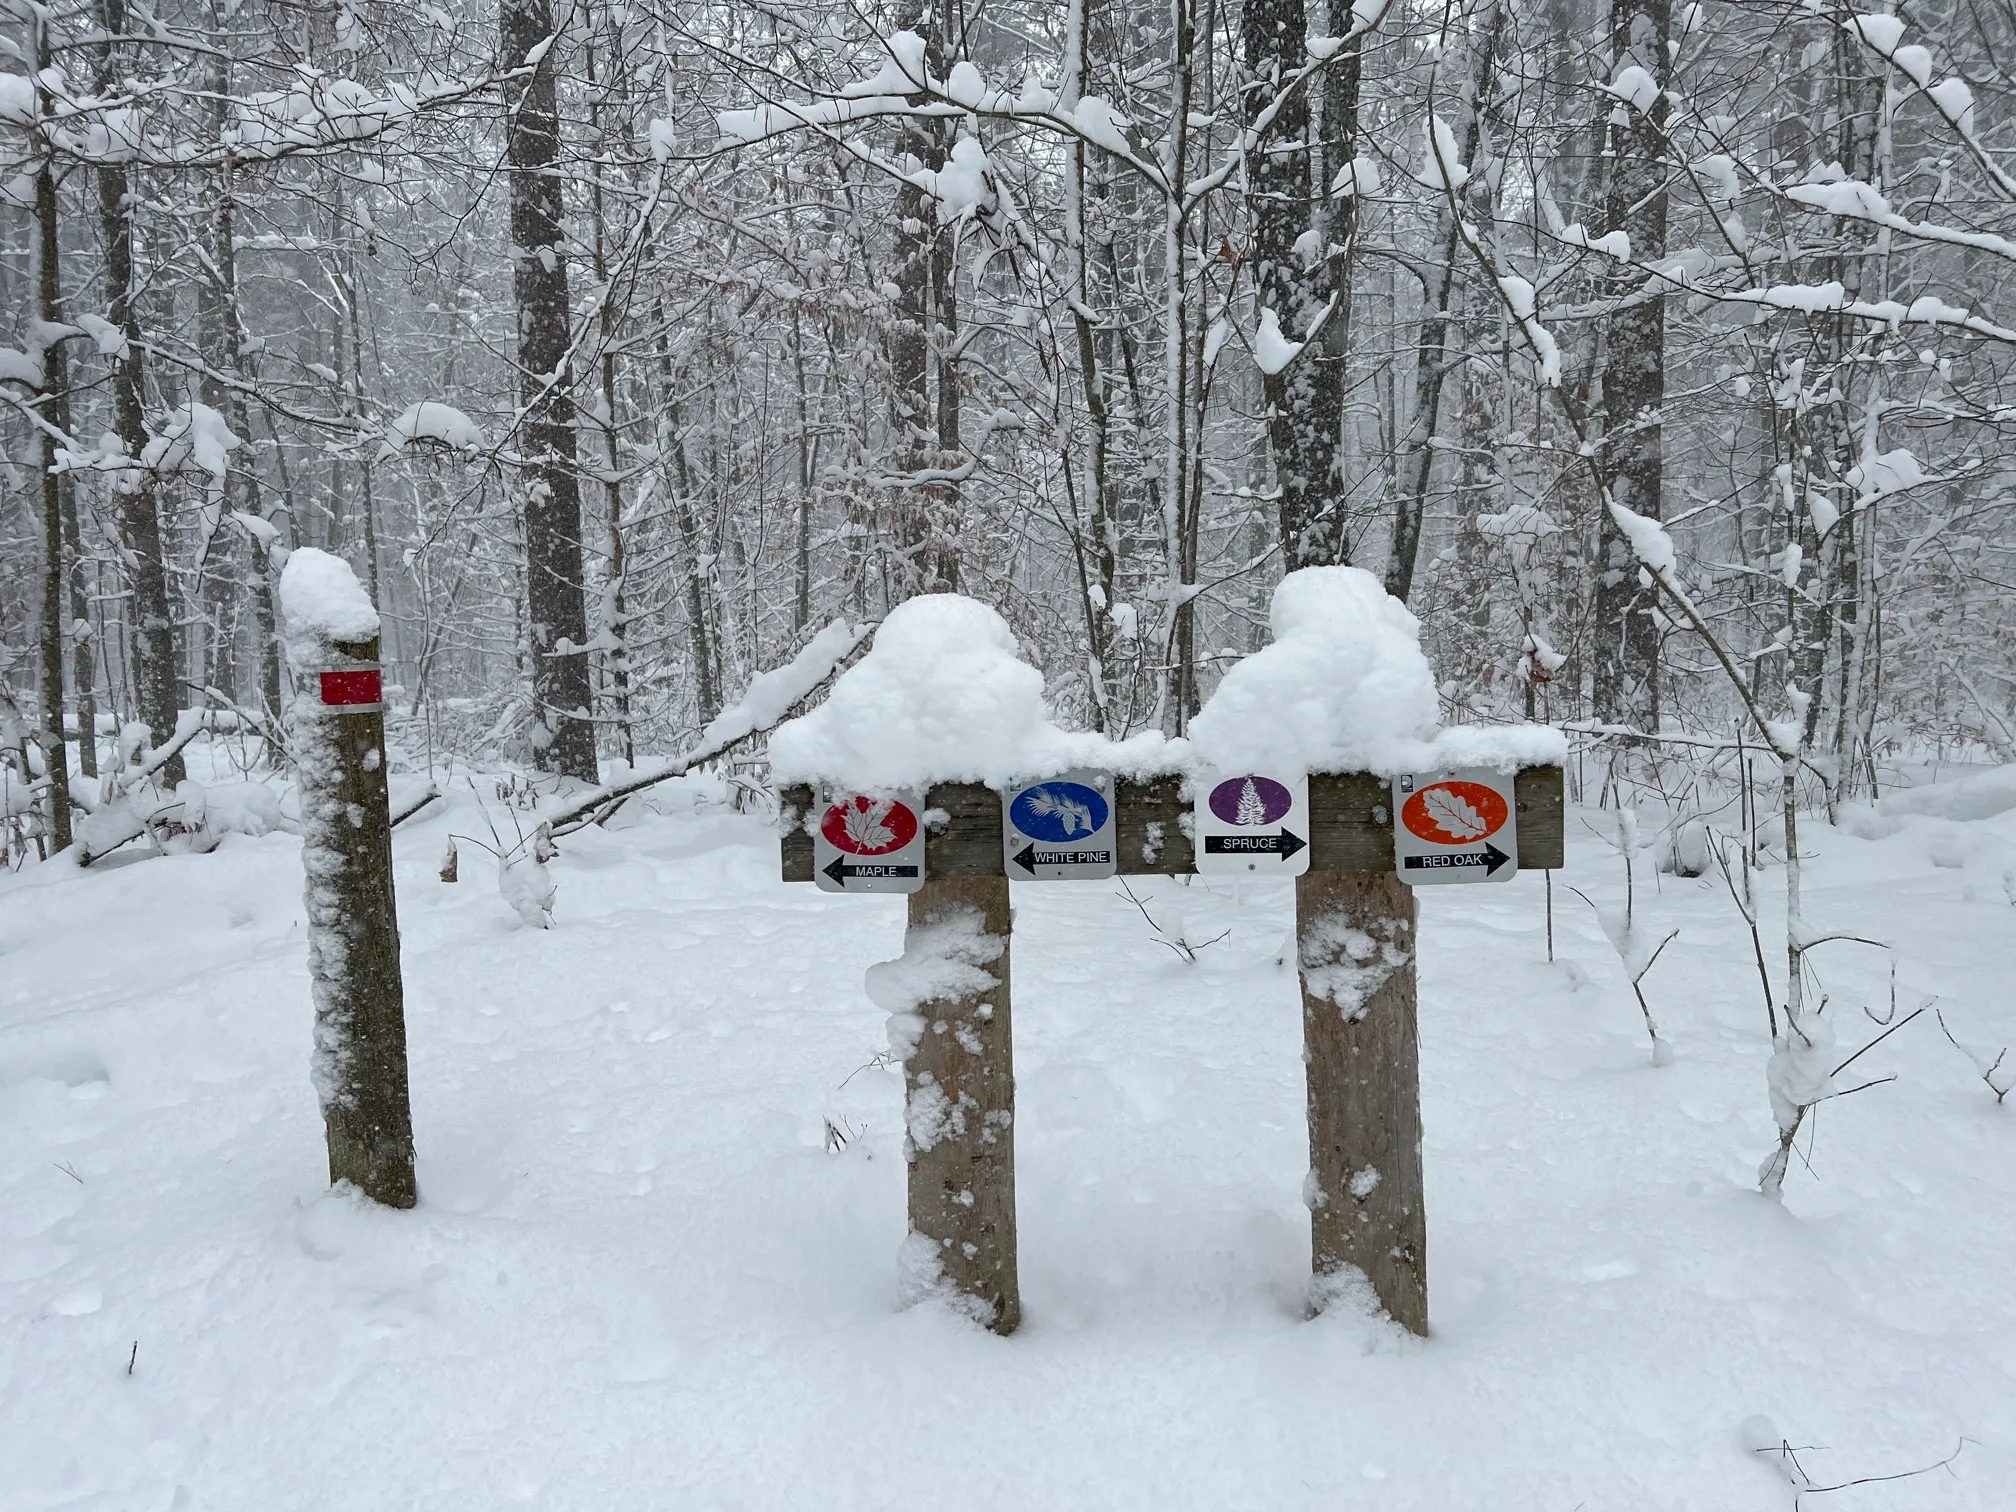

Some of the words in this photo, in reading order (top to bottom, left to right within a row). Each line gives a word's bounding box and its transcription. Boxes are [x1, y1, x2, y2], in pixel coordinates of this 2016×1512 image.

[1223, 838, 1277, 849] SPRUCE
[1034, 852, 1075, 863] WHITE
[1078, 851, 1107, 862] PINE
[1422, 855, 1450, 866] RED
[1454, 854, 1483, 865] OAK
[855, 866, 897, 877] MAPLE
